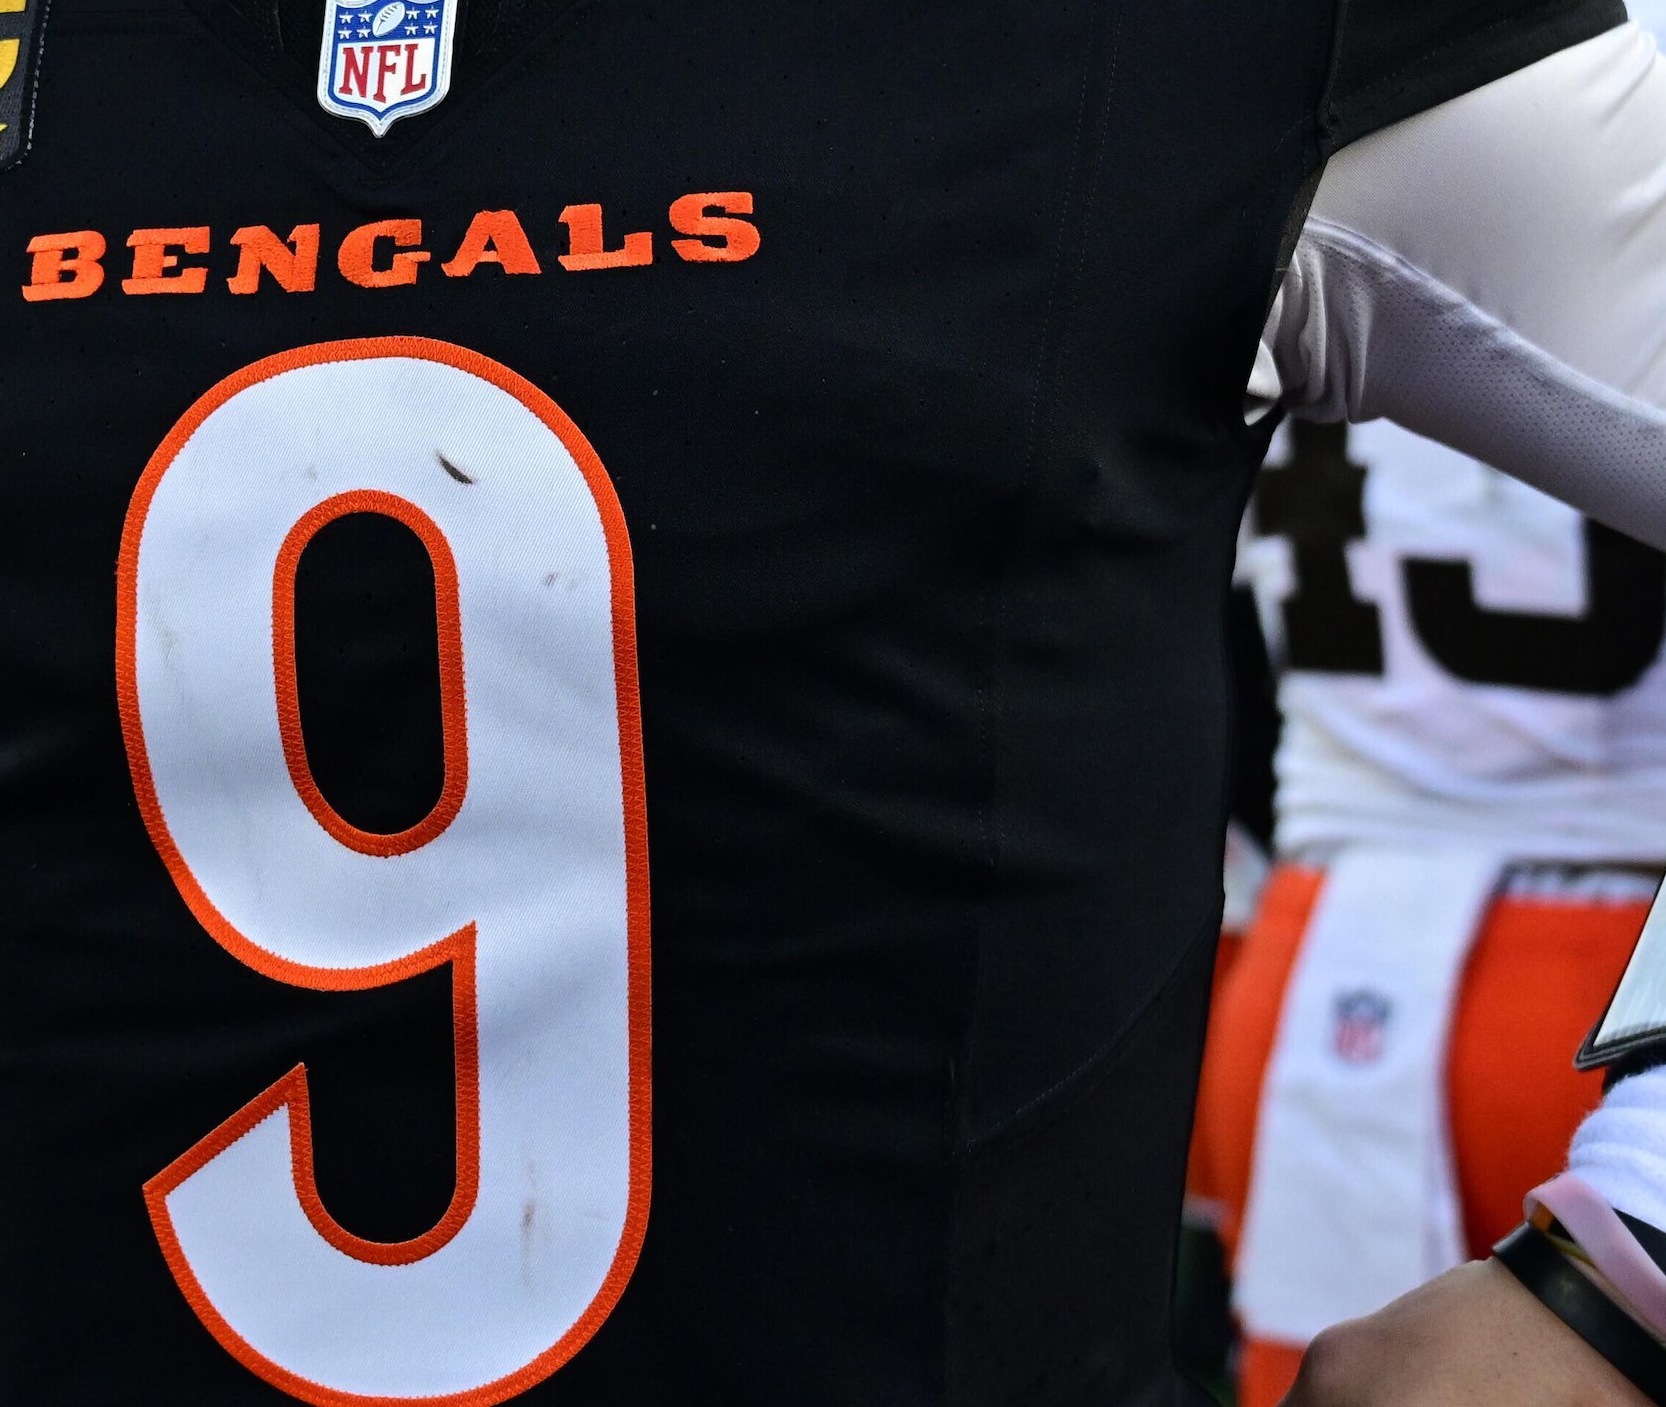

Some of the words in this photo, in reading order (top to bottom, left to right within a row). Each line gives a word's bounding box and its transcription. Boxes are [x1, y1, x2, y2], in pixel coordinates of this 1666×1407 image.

[338, 43, 427, 104] NFL
[22, 191, 762, 302] BENGALS
[116, 335, 652, 1407] 9
